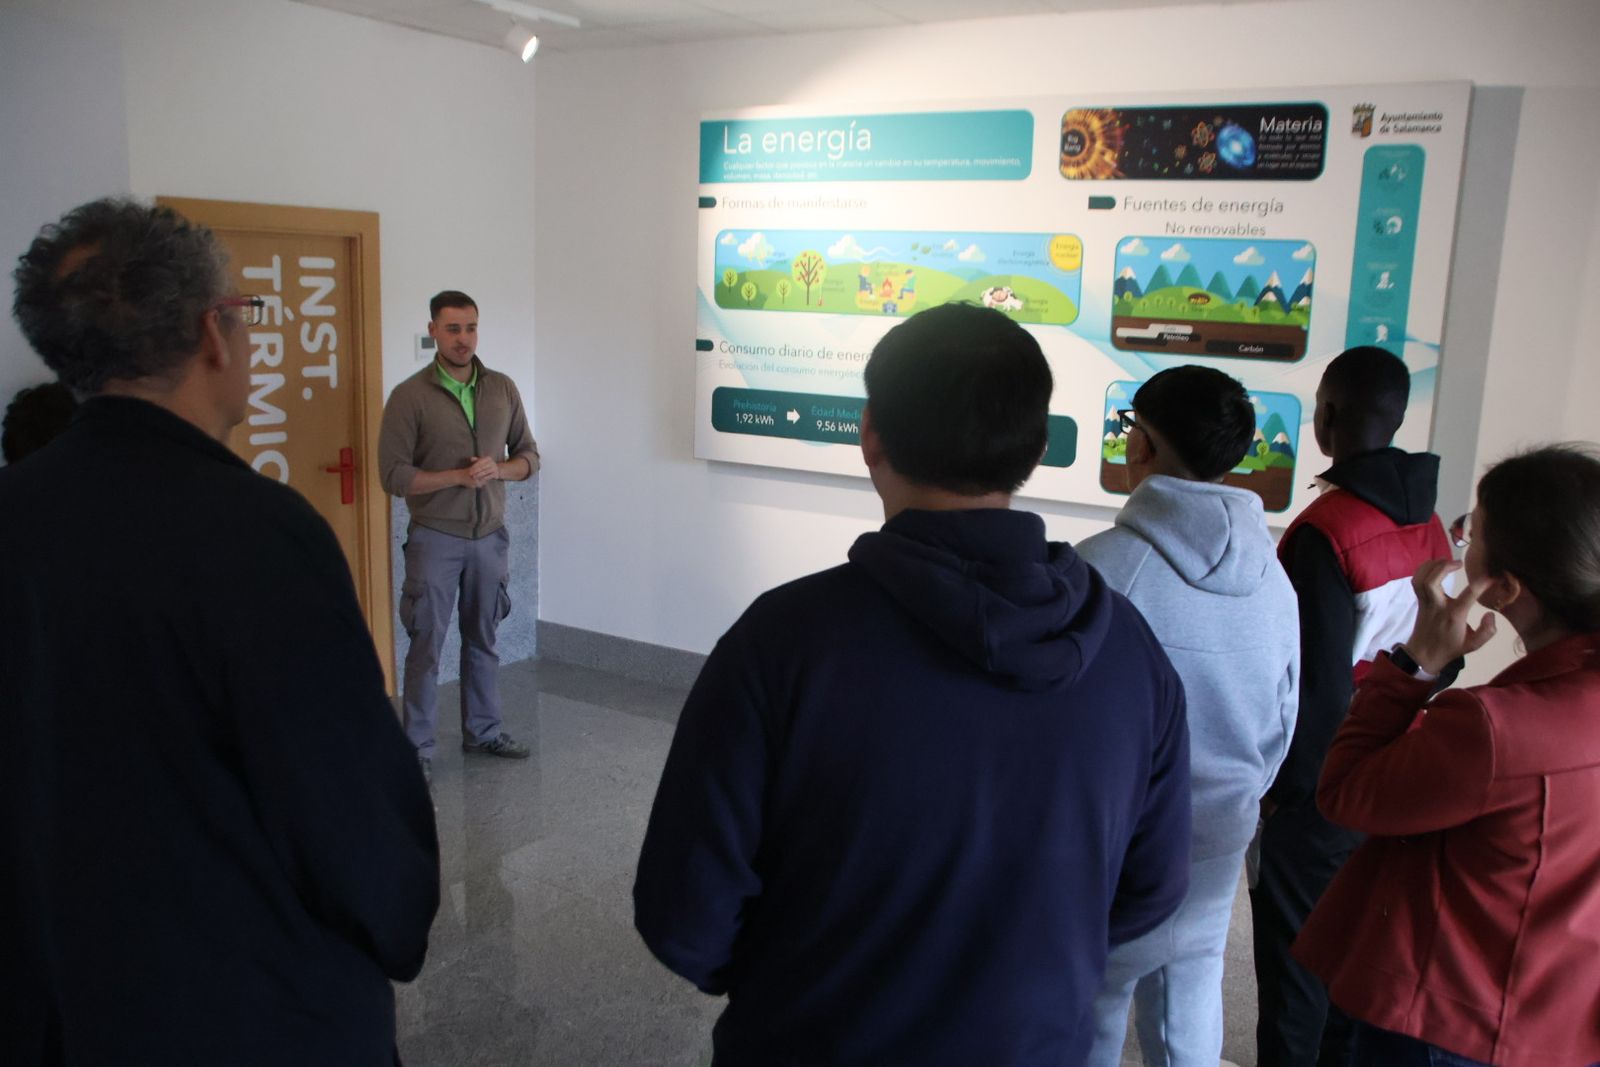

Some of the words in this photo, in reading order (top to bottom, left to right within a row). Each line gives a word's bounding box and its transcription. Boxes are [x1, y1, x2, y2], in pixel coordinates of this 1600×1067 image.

[1259, 115, 1322, 133] Materia
[1381, 112, 1443, 124] Ayuntamiento
[1393, 123, 1442, 134] Salamanca
[723, 125, 751, 154] La
[762, 121, 871, 160] energía
[722, 196, 765, 208] Formas
[768, 195, 785, 208] de
[788, 195, 868, 208] manifestarse
[1124, 196, 1187, 213] Fuentes
[1192, 196, 1213, 213] de
[1219, 198, 1285, 217] energía
[1166, 221, 1185, 235] No
[1190, 222, 1266, 236] renovables
[299, 257, 337, 400] INST.
[719, 341, 775, 356] Consumo
[779, 344, 814, 359] diario
[817, 346, 833, 359] de
[760, 361, 774, 373] del
[776, 365, 816, 376] consumo
[733, 399, 777, 412] Prehistoria
[811, 405, 834, 417] Edad
[735, 412, 753, 425] 1,92
[755, 413, 774, 426] kWh
[816, 419, 836, 432] 9,56
[838, 421, 859, 434] kWh
